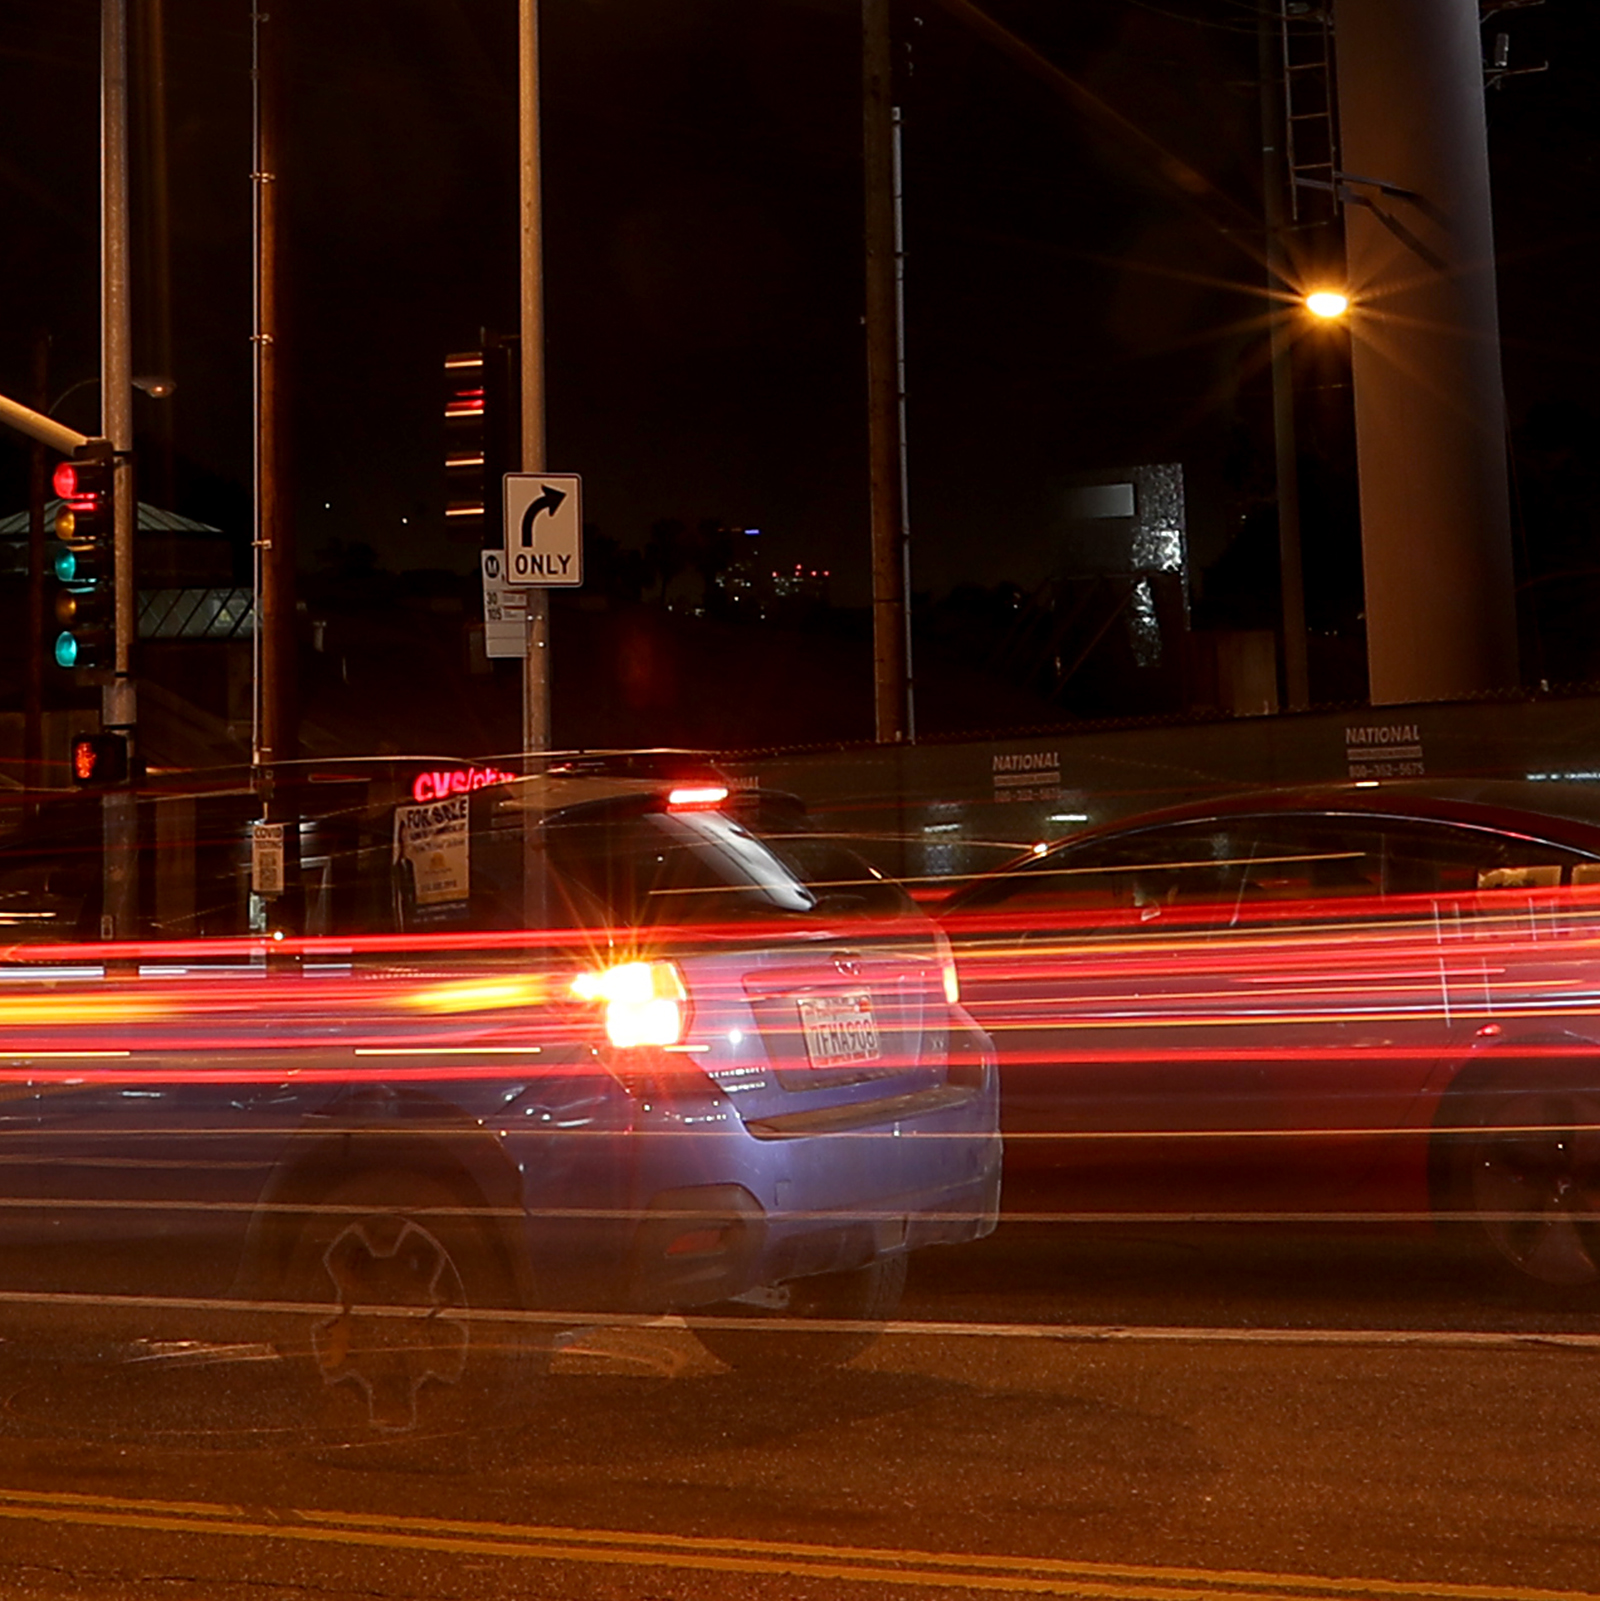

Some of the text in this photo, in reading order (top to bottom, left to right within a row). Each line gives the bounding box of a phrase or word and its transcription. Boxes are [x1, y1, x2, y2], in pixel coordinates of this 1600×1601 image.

[515, 554, 571, 575] ONLY
[1345, 724, 1420, 744] NATIONAL
[992, 751, 1061, 771] NATIONAL
[407, 799, 467, 829] FOR SALE
